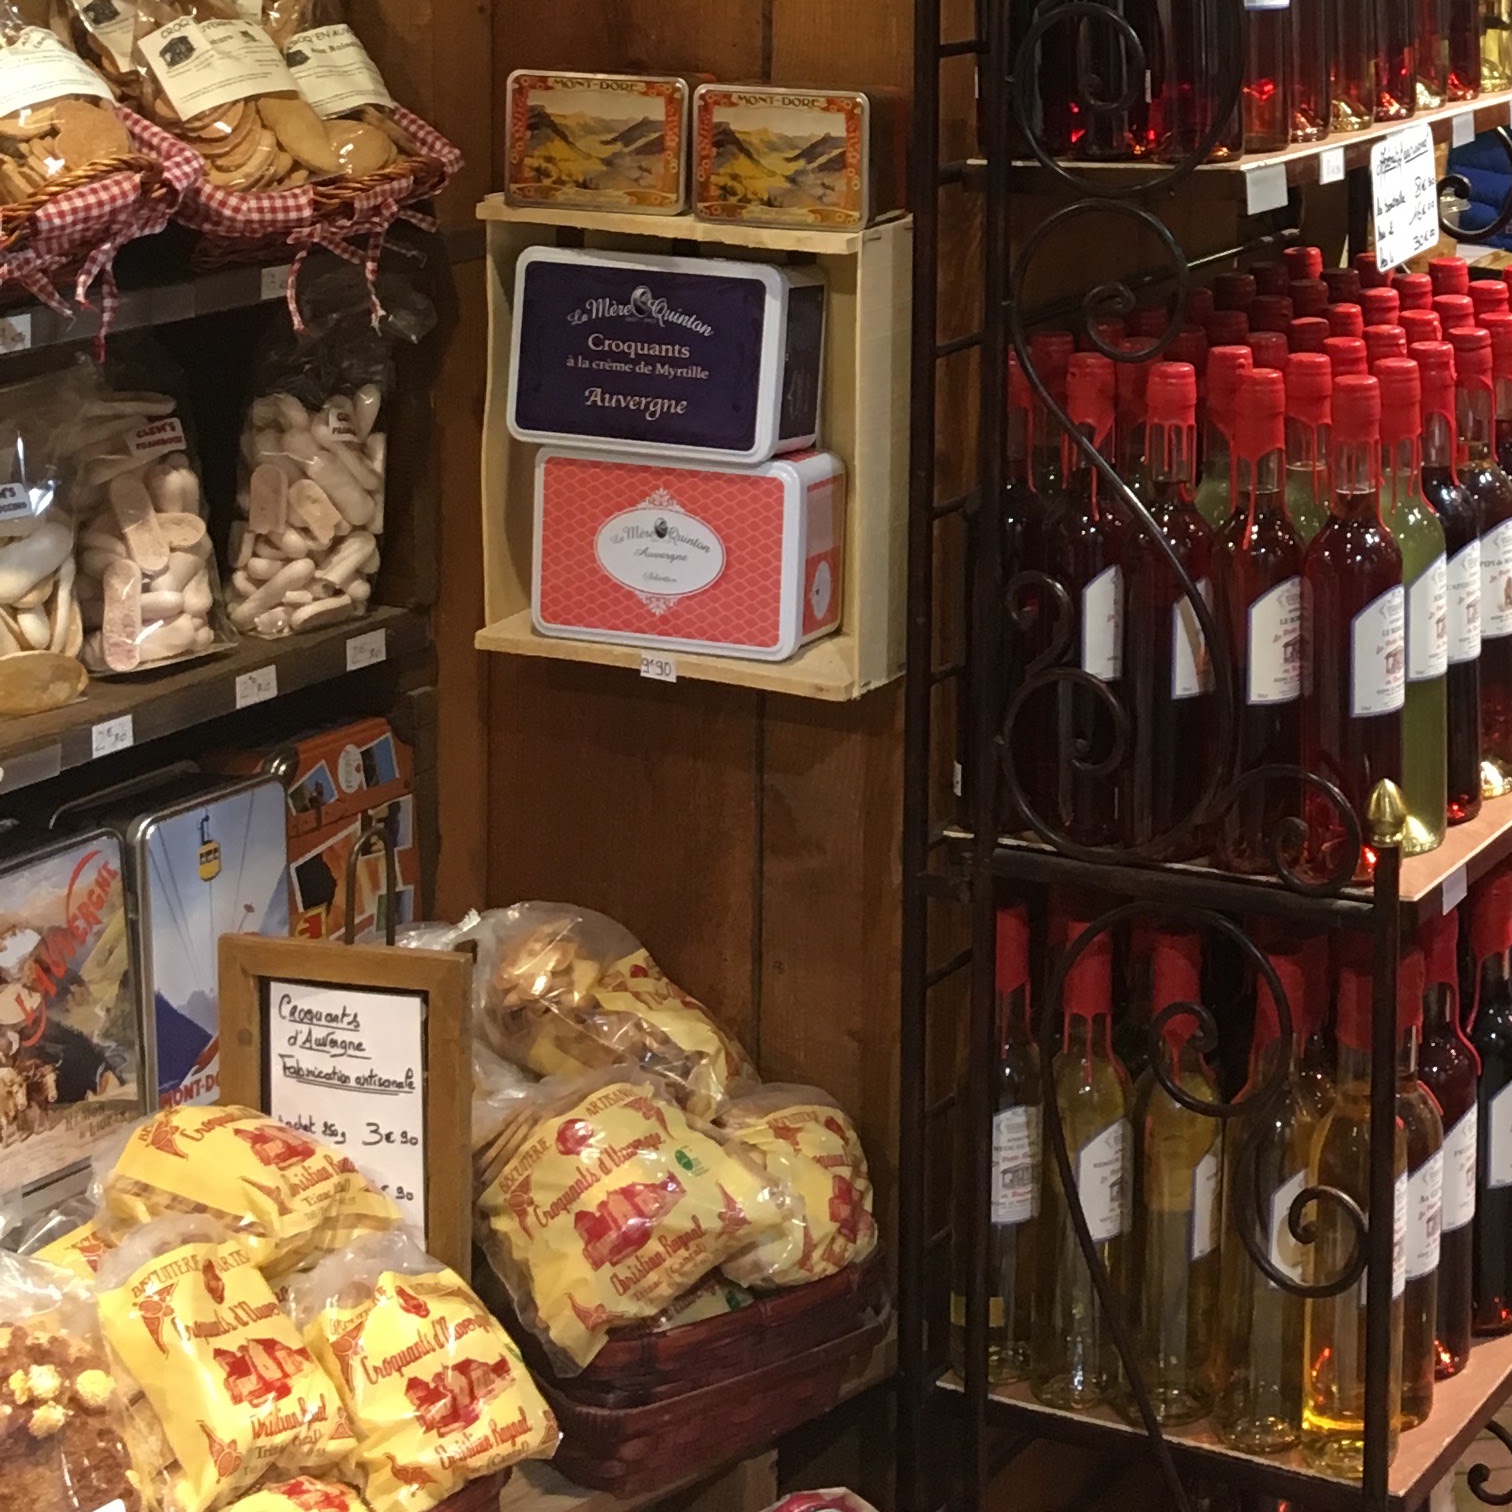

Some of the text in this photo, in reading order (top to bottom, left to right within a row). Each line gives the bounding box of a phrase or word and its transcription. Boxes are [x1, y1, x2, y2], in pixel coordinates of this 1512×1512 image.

[552, 77, 639, 92] MONT-DORE
[737, 93, 822, 109] MONT-DORE
[586, 295, 633, 320] Mère
[651, 296, 714, 338] Quinton
[588, 333, 690, 359] Croquants
[566, 354, 709, 380] à la crème de Myrtille
[584, 387, 688, 421] Auvergne
[623, 525, 654, 542] Mère
[667, 525, 711, 555] Quinton
[633, 546, 688, 562] Auvergne
[278, 993, 361, 1031] Croquants
[287, 1029, 368, 1059] d'Auvergne
[278, 1053, 416, 1090] Fabrication artisanale
[534, 1165, 601, 1228] Croquants
[609, 1247, 666, 1297] Christian
[360, 1328, 436, 1386] Croquants
